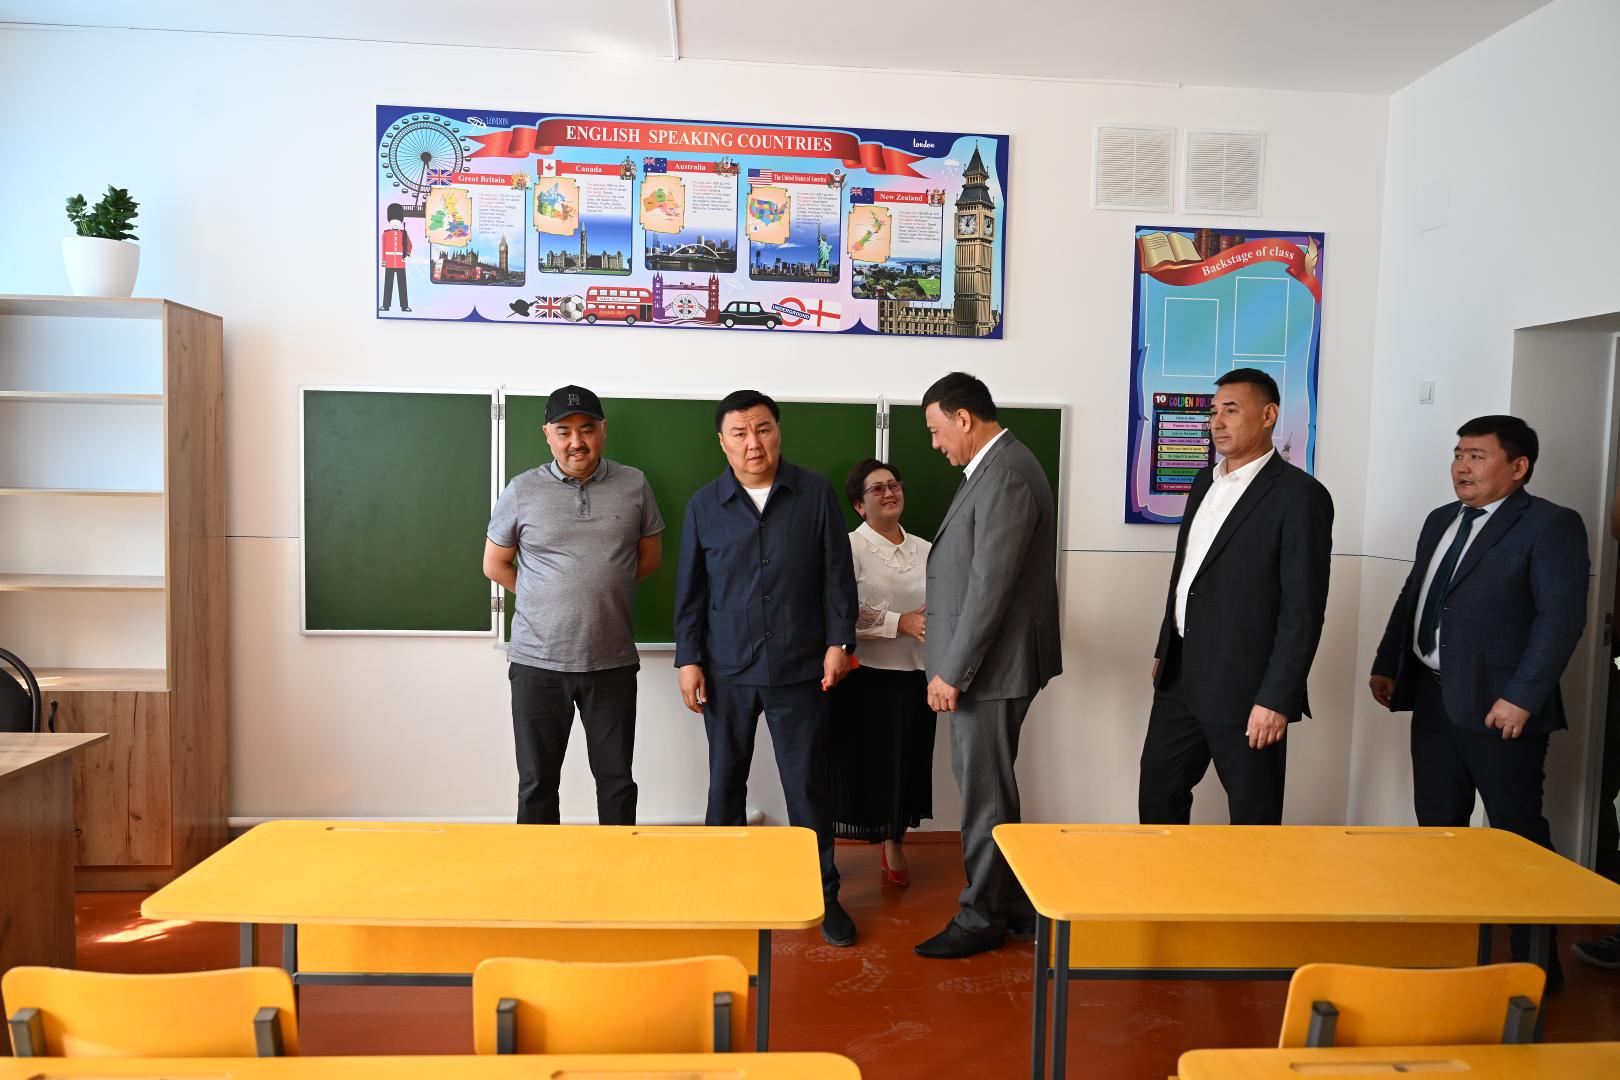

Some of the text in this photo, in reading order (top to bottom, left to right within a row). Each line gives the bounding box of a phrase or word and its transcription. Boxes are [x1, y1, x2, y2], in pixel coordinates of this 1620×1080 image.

[486, 116, 509, 126] LONDON
[565, 125, 833, 152] ENGLISH SPEAKING COUNTRIES
[575, 164, 603, 174] Canada
[674, 163, 706, 172] Australia
[458, 174, 505, 184] Great Britain
[773, 173, 782, 181] The
[782, 174, 795, 182] United
[795, 174, 806, 182] States
[811, 175, 827, 183] America
[896, 193, 923, 202] Zealand
[1202, 245, 1295, 277] Backstage of class
[772, 304, 810, 320] UNDERGROUND
[1155, 395, 1167, 403] 10
[1169, 396, 1194, 408] GOLDEN
